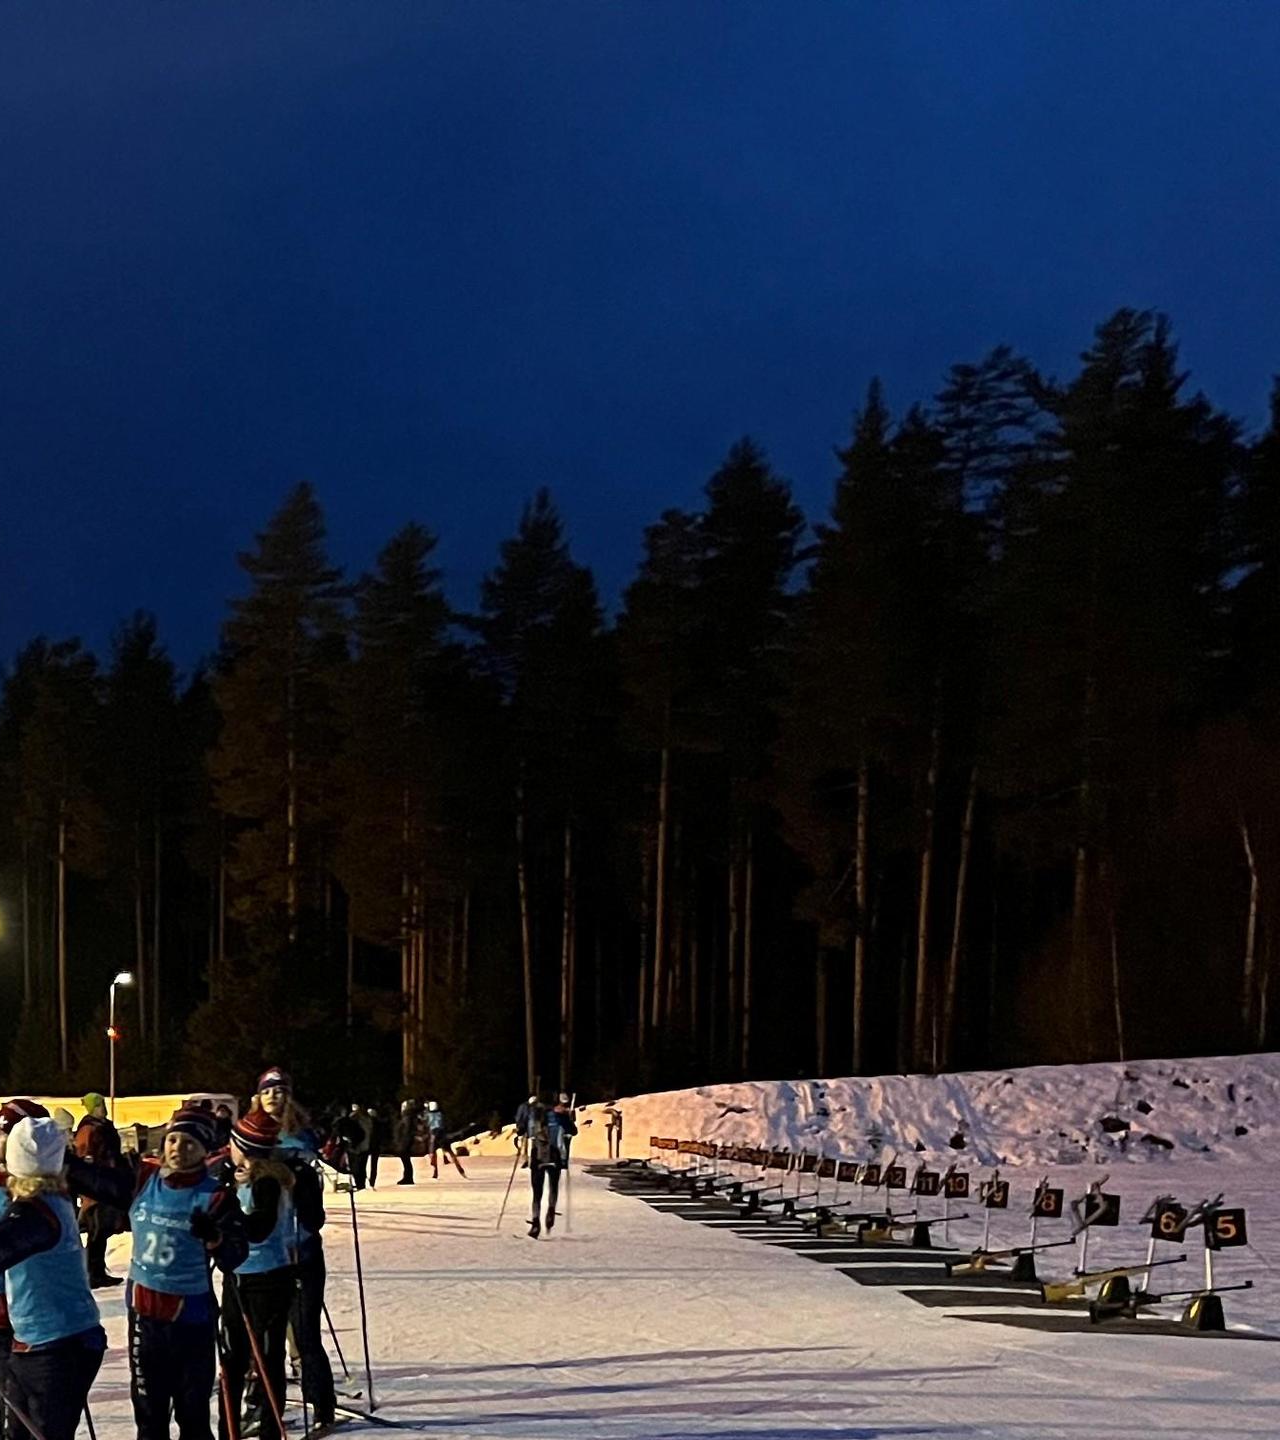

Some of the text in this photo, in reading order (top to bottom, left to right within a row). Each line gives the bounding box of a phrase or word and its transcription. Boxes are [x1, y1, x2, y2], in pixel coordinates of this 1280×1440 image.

[919, 1177, 936, 1191] 11
[946, 1176, 967, 1192] 10
[1041, 1193, 1056, 1212] 8
[1160, 1211, 1178, 1233] 6
[1216, 1215, 1237, 1239] 5
